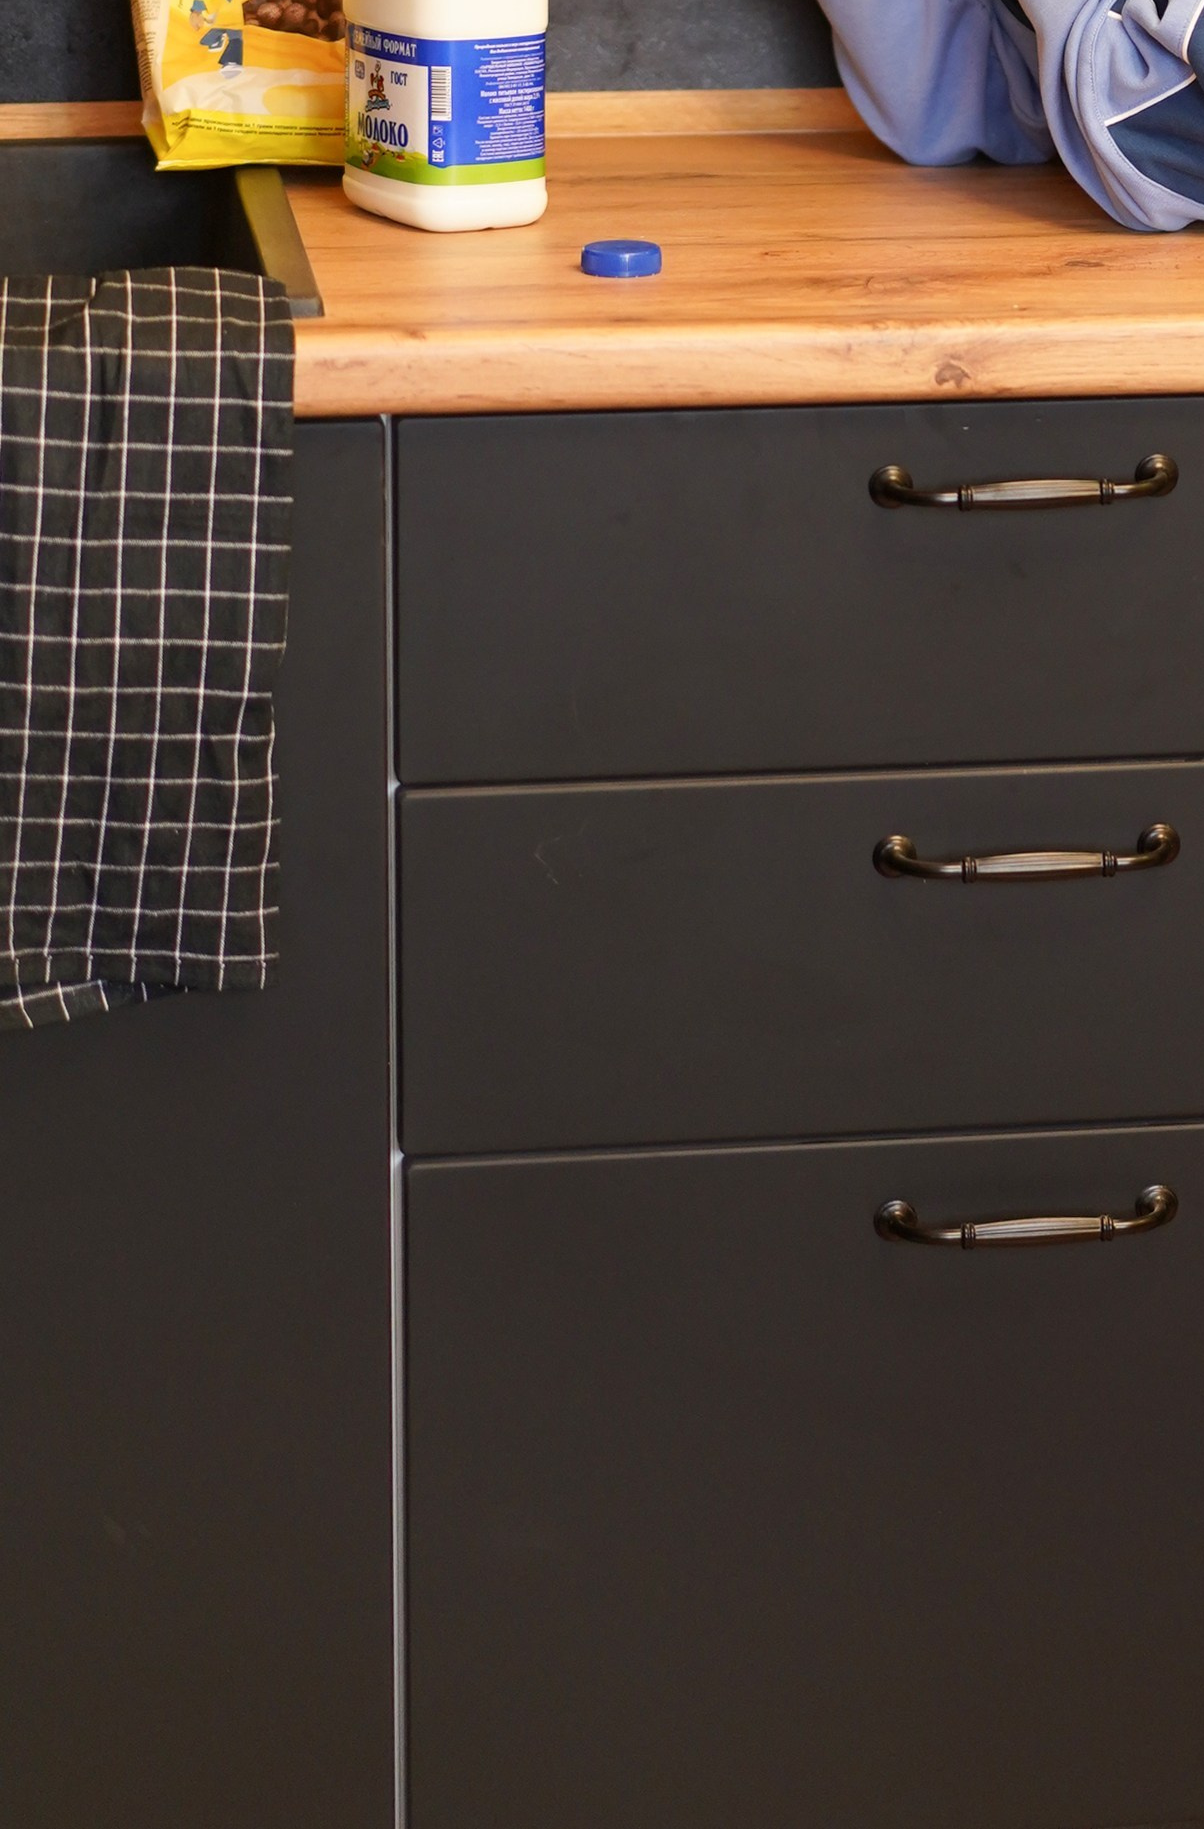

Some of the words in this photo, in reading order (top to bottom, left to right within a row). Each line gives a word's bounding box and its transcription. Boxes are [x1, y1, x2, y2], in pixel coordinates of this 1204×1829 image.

[383, 38, 417, 58] ФОРМАТ
[390, 70, 408, 86] ГОСТ
[357, 111, 408, 148] МОЛОКО
